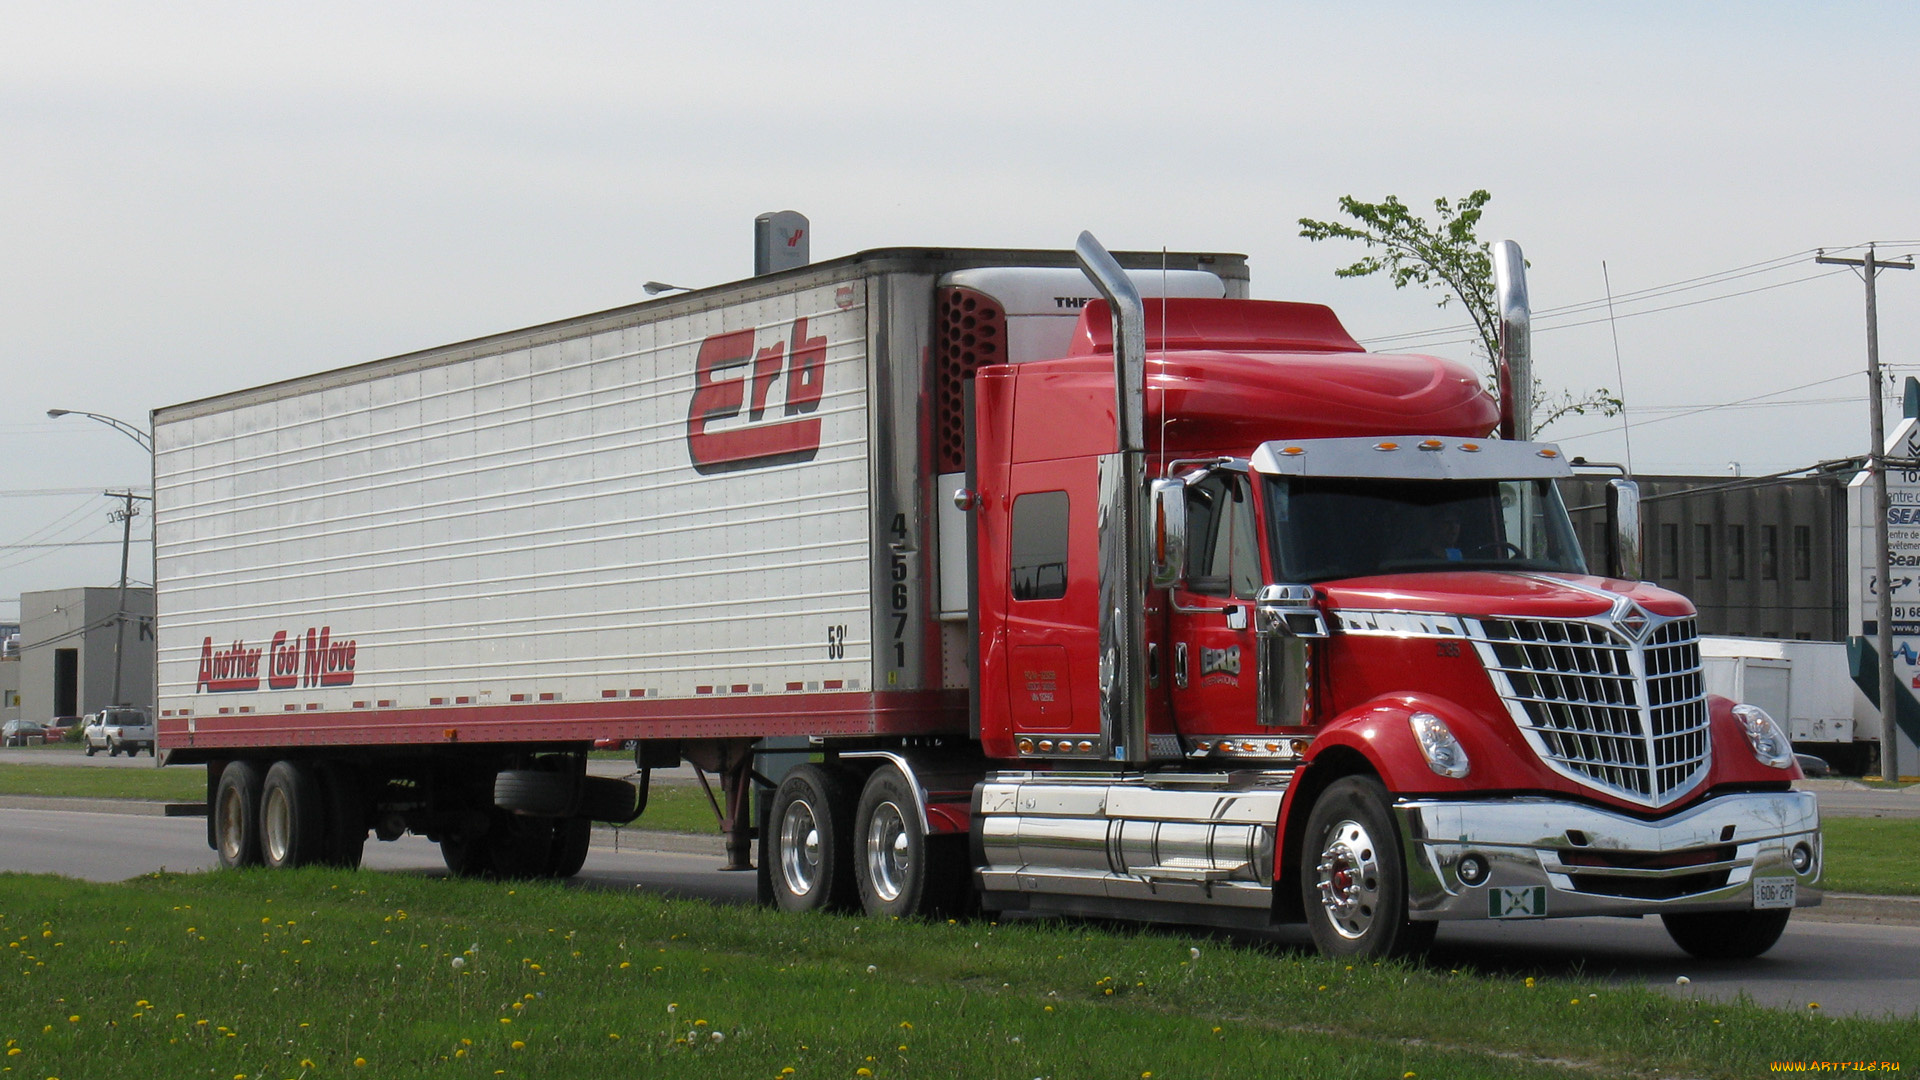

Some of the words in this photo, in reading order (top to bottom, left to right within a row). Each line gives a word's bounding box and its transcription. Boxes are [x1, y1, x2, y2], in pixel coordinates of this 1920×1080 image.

[1054, 297, 1095, 308] THE
[687, 316, 828, 476] Erb
[1901, 470, 1920, 483] 10
[1887, 490, 1913, 503] entre
[1888, 530, 1909, 539] entre
[828, 624, 847, 660] 53'
[196, 636, 262, 694] Another
[268, 630, 301, 690] Cool
[303, 626, 356, 689] Move
[1200, 645, 1241, 677] ERB
